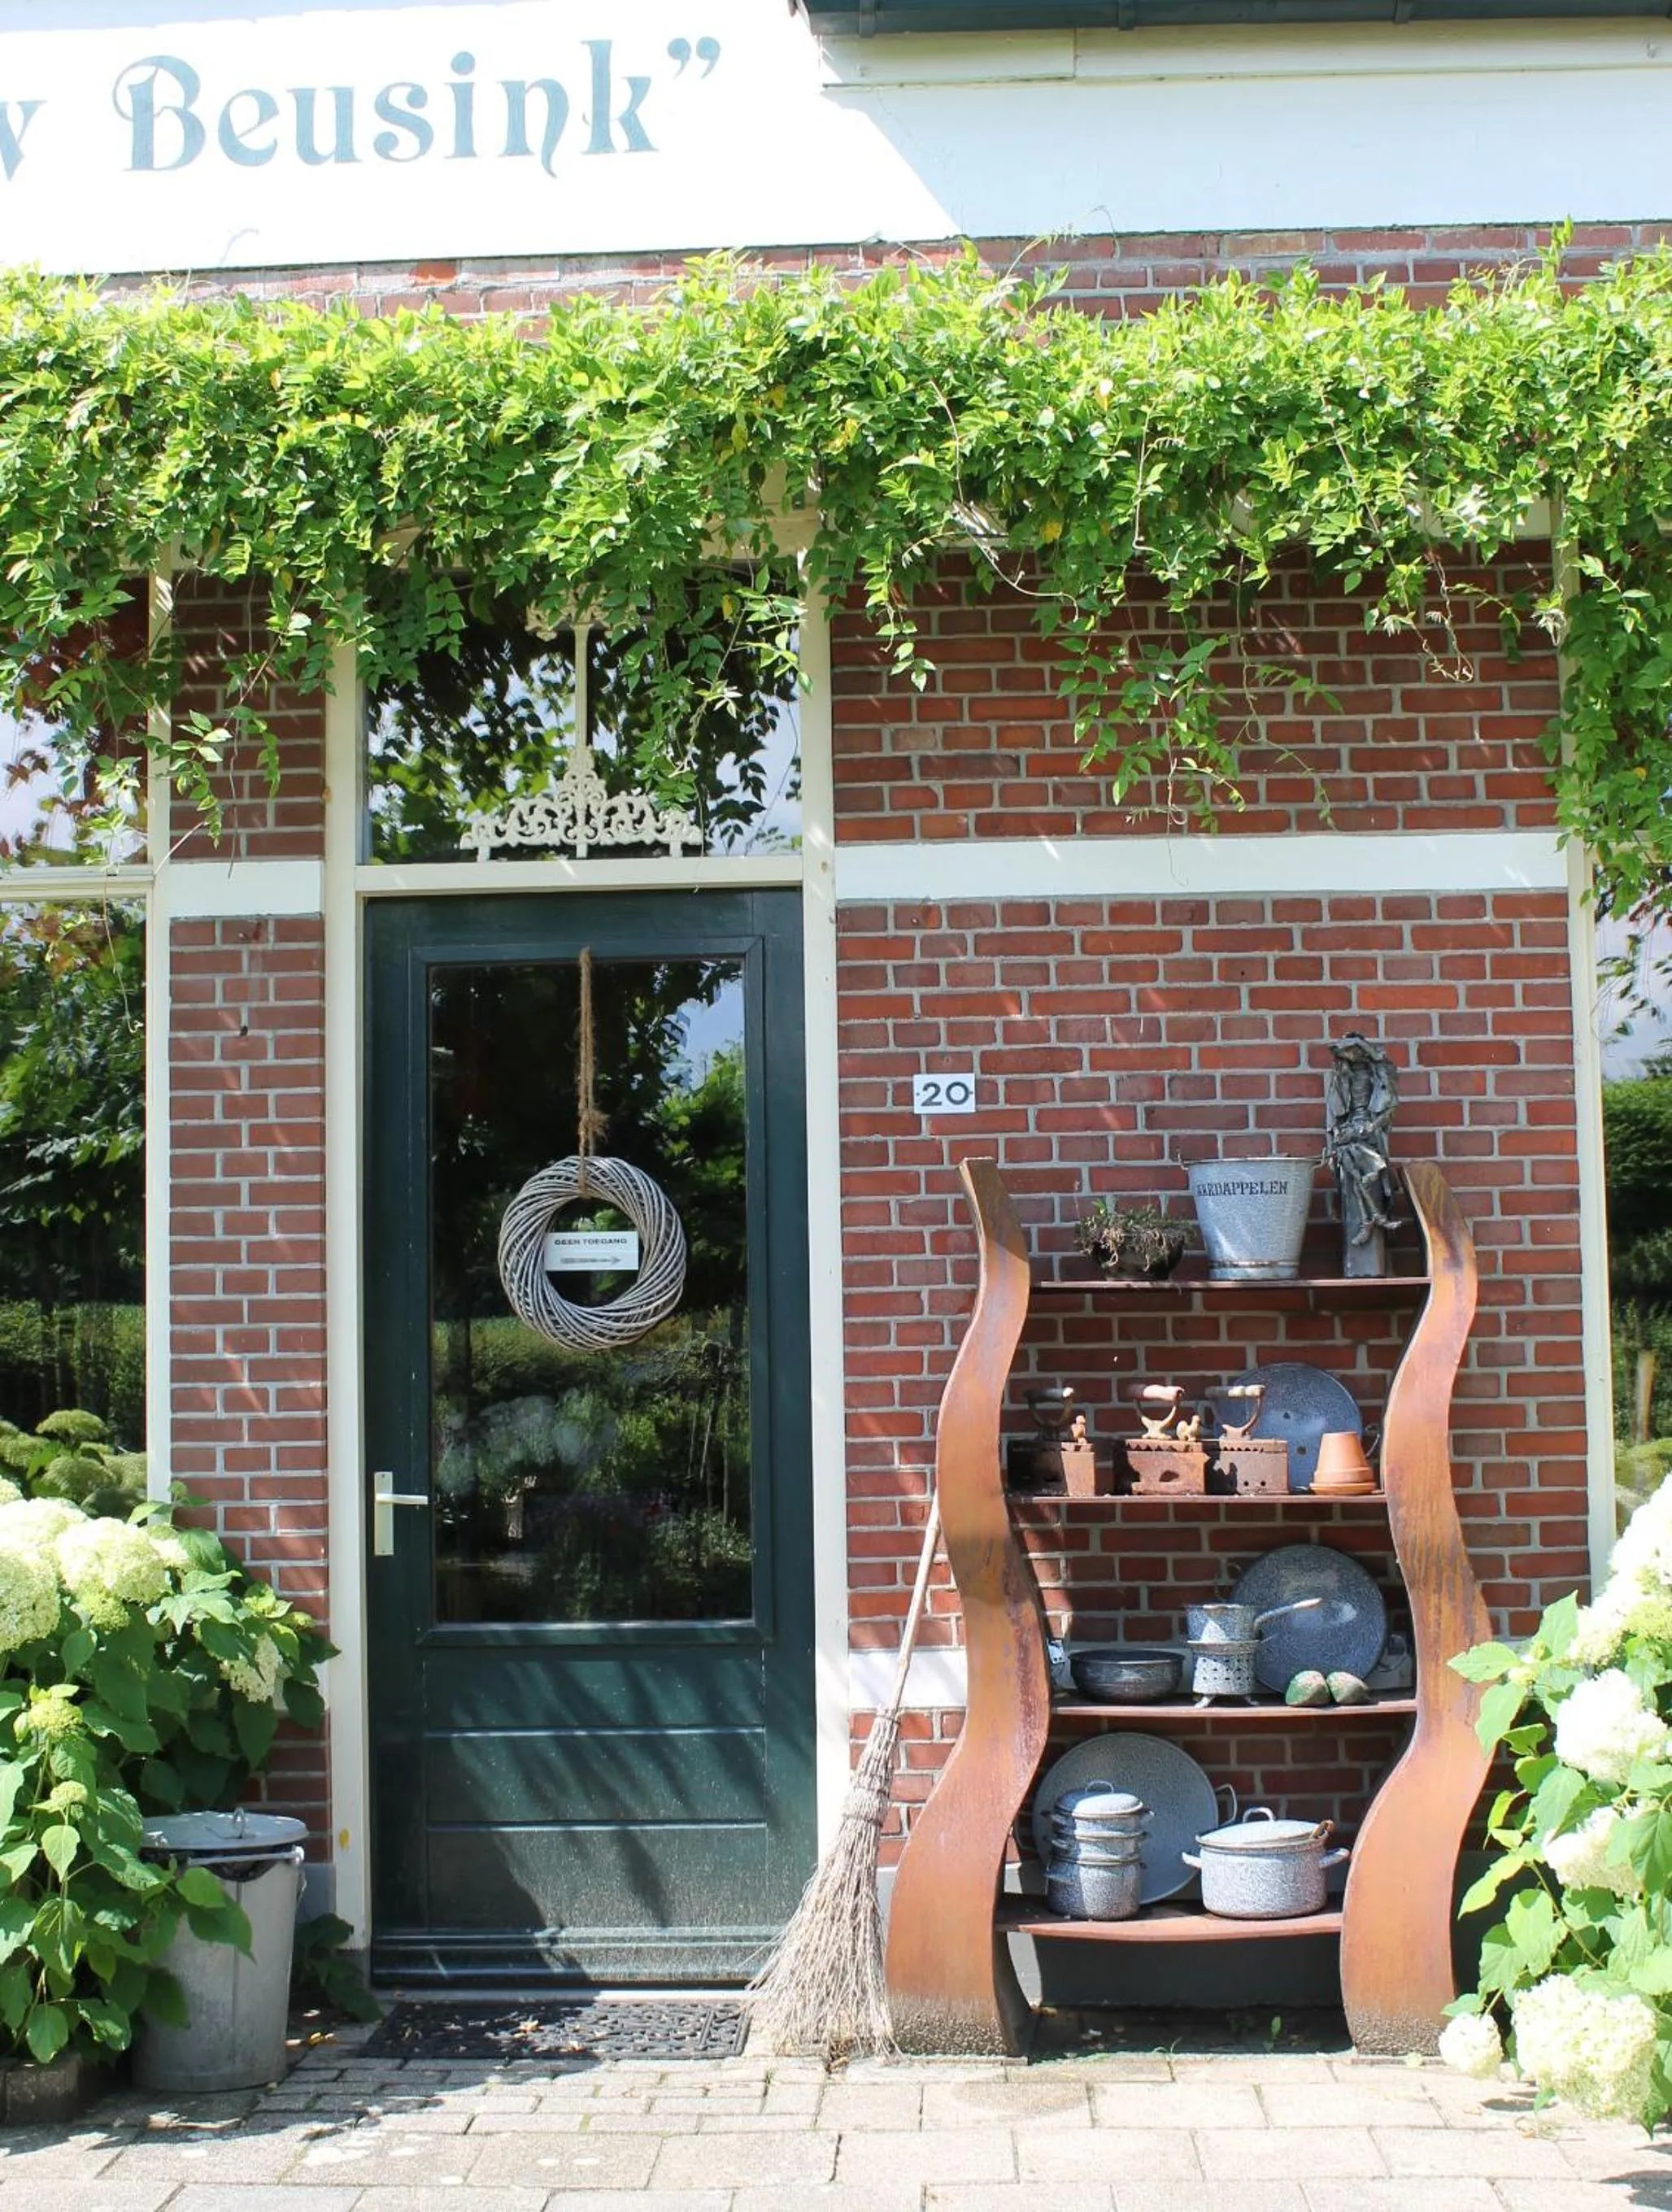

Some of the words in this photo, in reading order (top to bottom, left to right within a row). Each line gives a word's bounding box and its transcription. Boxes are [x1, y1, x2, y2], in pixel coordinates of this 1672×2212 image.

[921, 1081, 969, 1107] 20
[1196, 1180, 1288, 1197] AARDAPPELEN
[583, 1237, 627, 1245] TOEGANG
